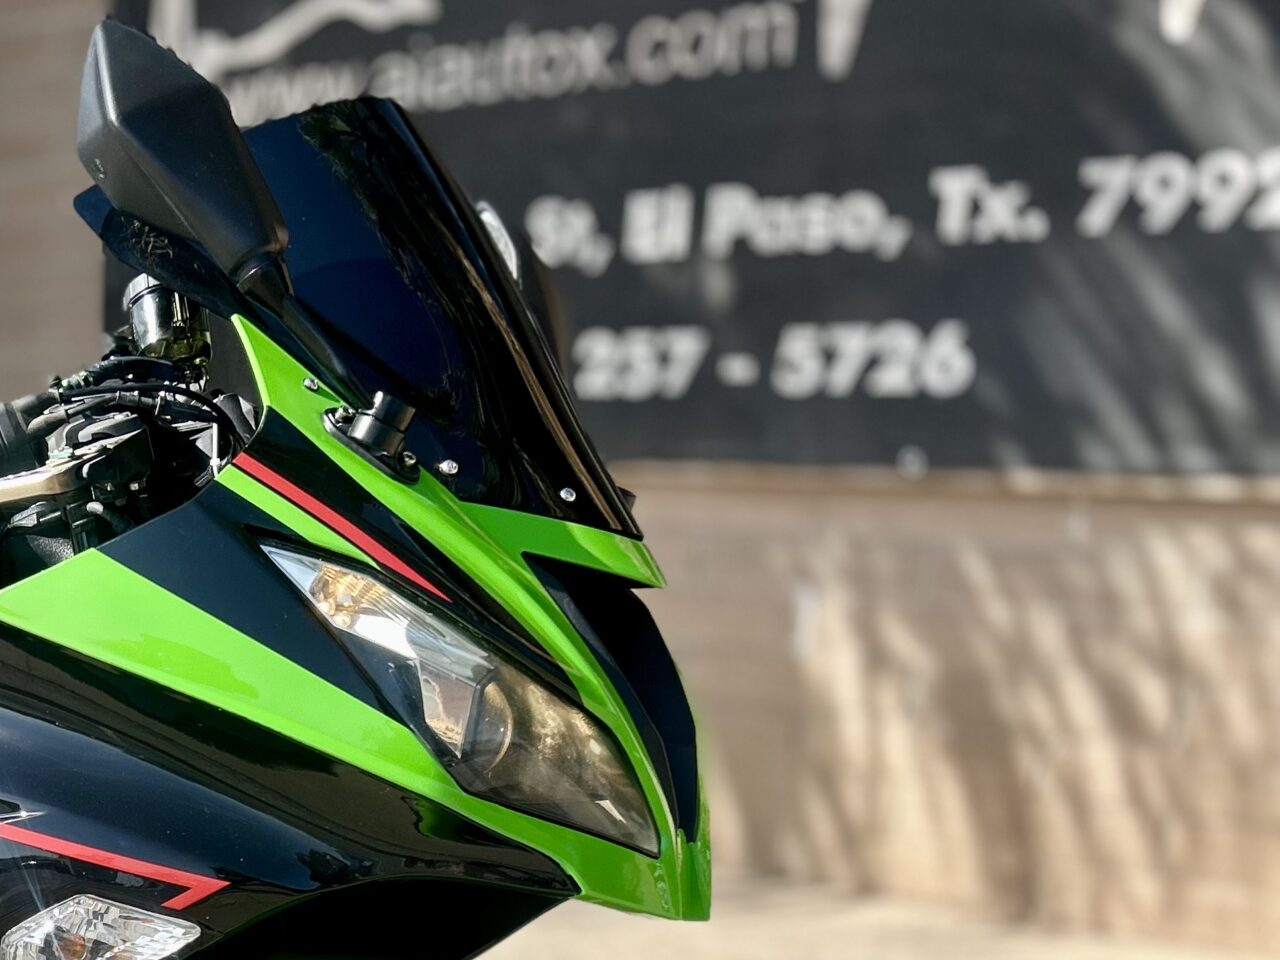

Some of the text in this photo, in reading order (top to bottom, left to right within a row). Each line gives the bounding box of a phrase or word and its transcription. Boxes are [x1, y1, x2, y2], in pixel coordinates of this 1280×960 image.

[622, 183, 693, 263] El
[701, 182, 910, 261] Paso,
[927, 164, 1051, 246] Tx.
[570, 324, 710, 401] 257
[769, 316, 977, 400] 5726
